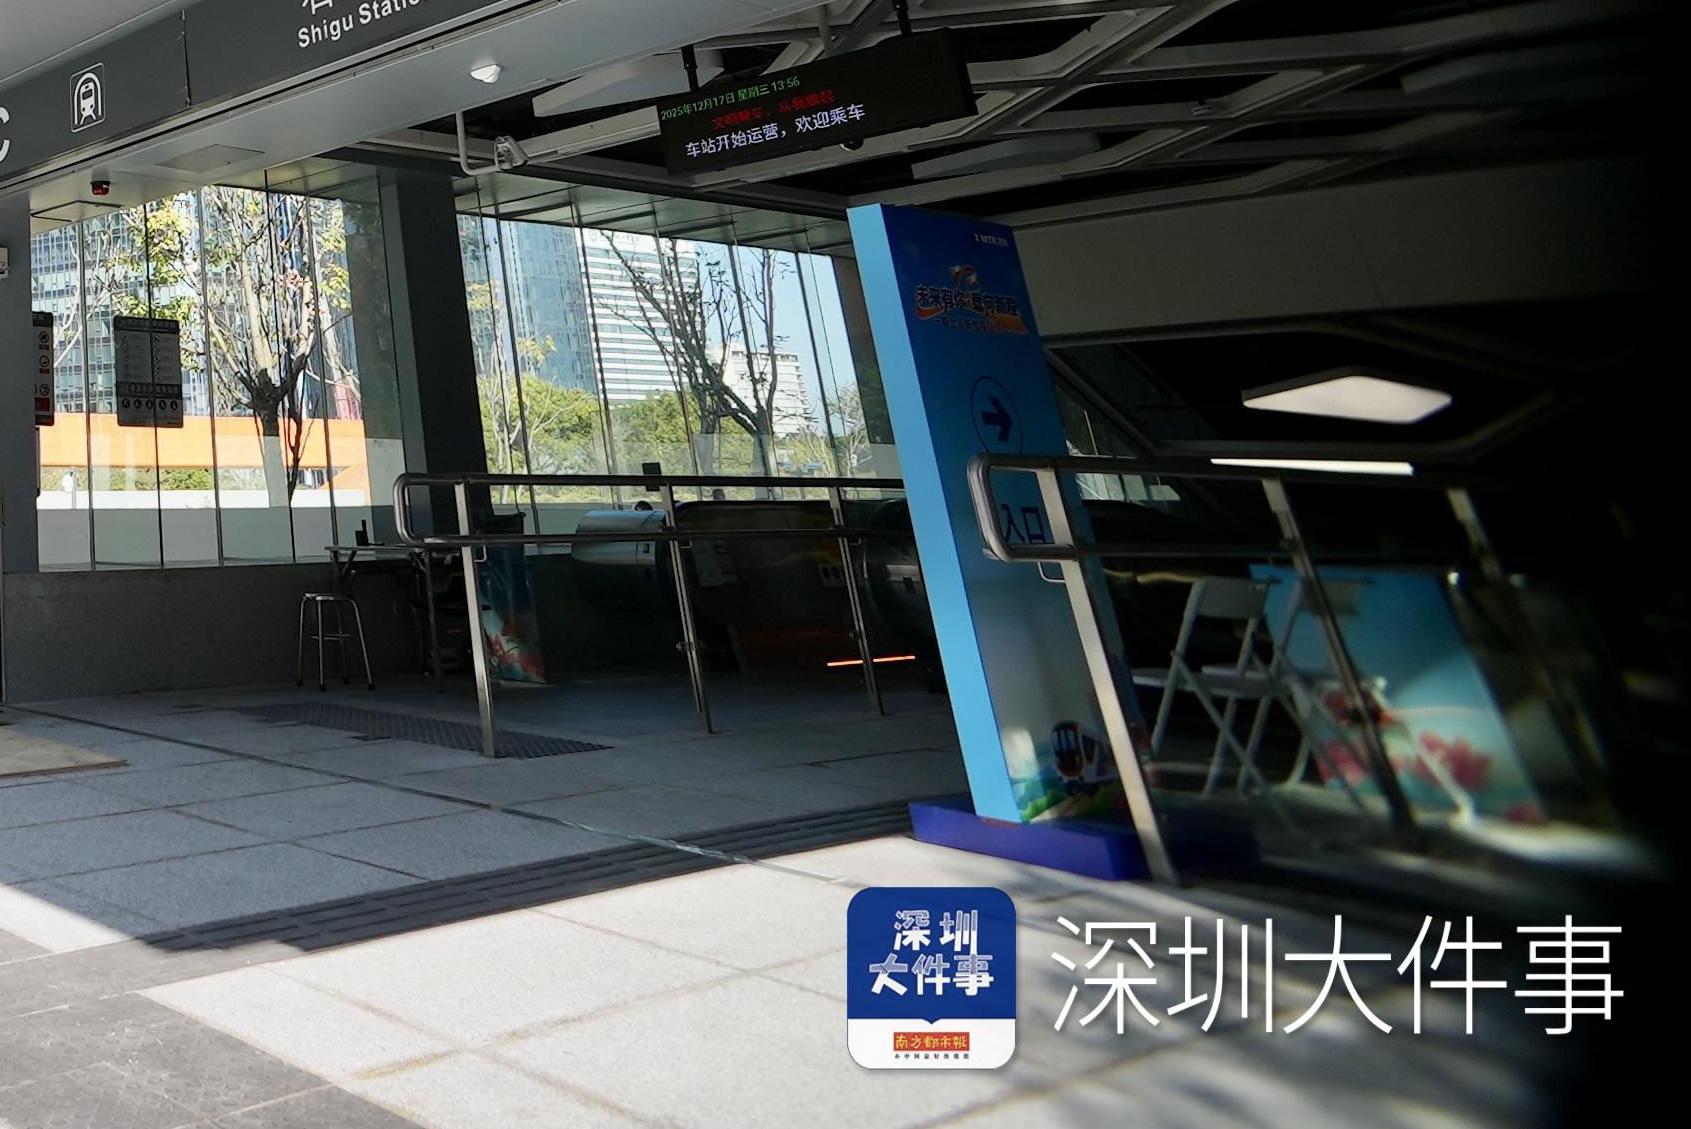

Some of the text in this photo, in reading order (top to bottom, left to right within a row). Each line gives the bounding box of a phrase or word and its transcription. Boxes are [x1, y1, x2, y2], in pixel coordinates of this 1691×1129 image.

[297, 14, 354, 48] Shigu
[661, 92, 735, 120] 2025年12月17日
[686, 103, 866, 158] 车站开始运营，欢迎乘车
[1001, 503, 1046, 544] 入口
